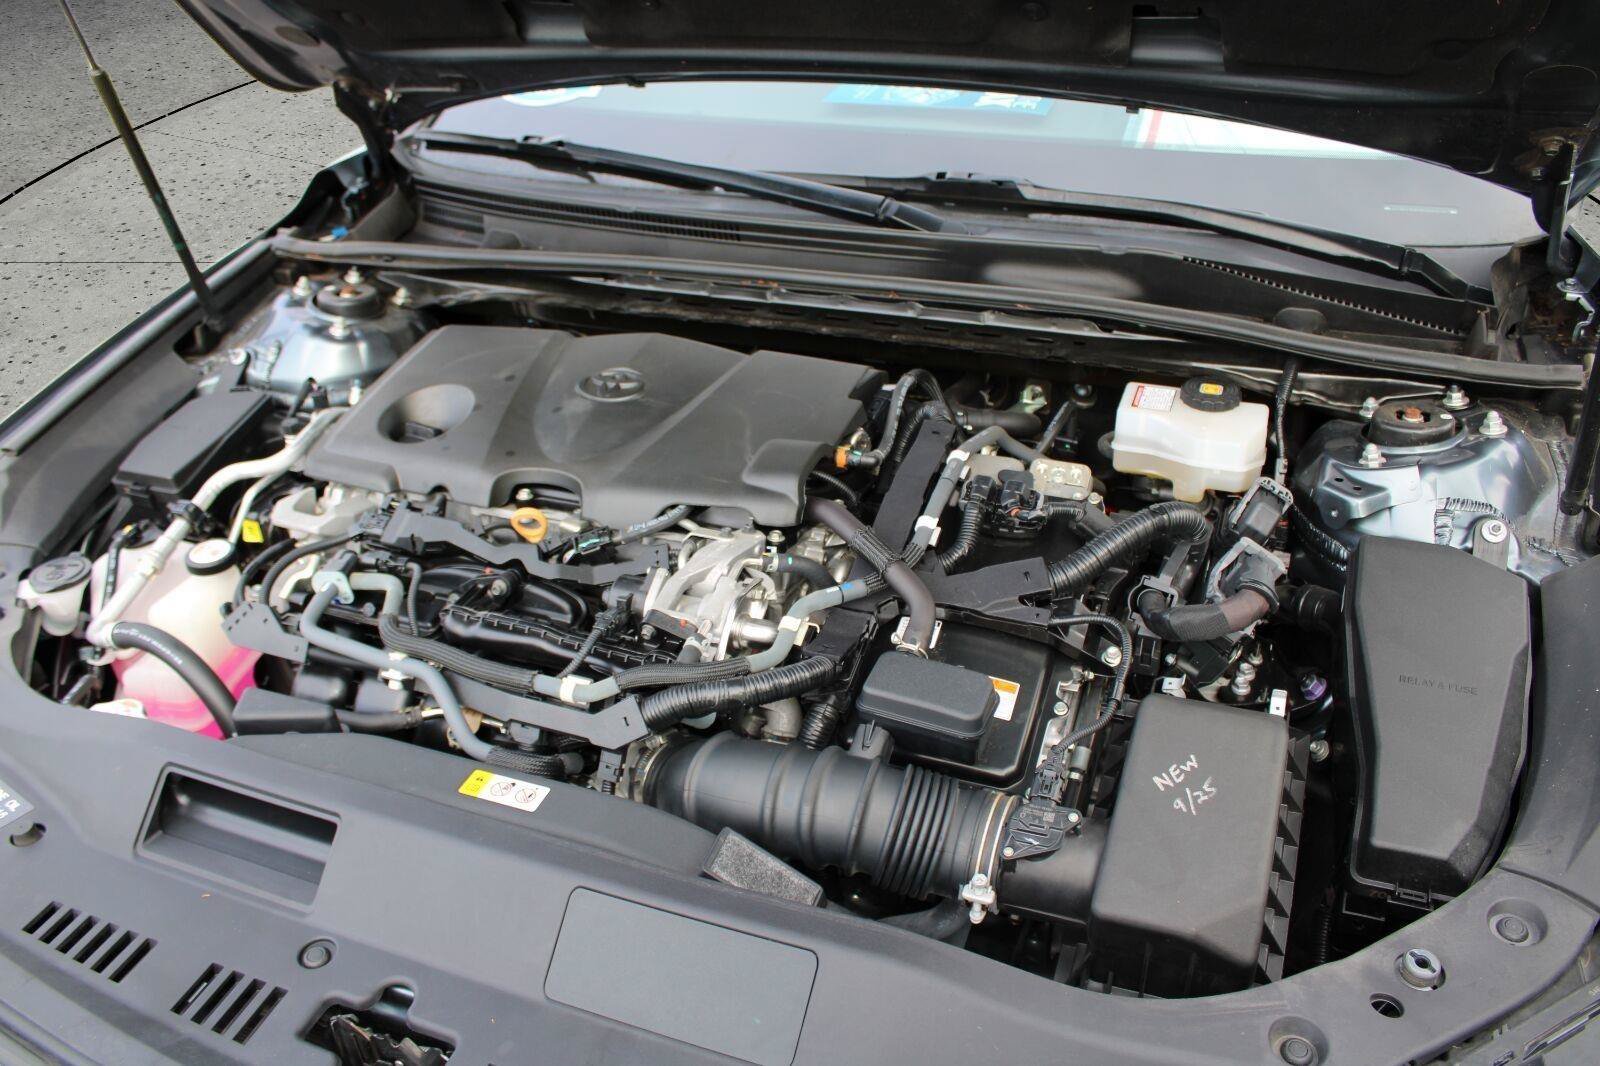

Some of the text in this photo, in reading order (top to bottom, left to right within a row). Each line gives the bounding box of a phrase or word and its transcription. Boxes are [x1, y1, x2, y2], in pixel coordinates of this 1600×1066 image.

[1399, 674, 1435, 687] RELAY
[1448, 683, 1478, 696] FUSE
[1152, 754, 1199, 791] NEW
[1173, 776, 1217, 815] 9/25
